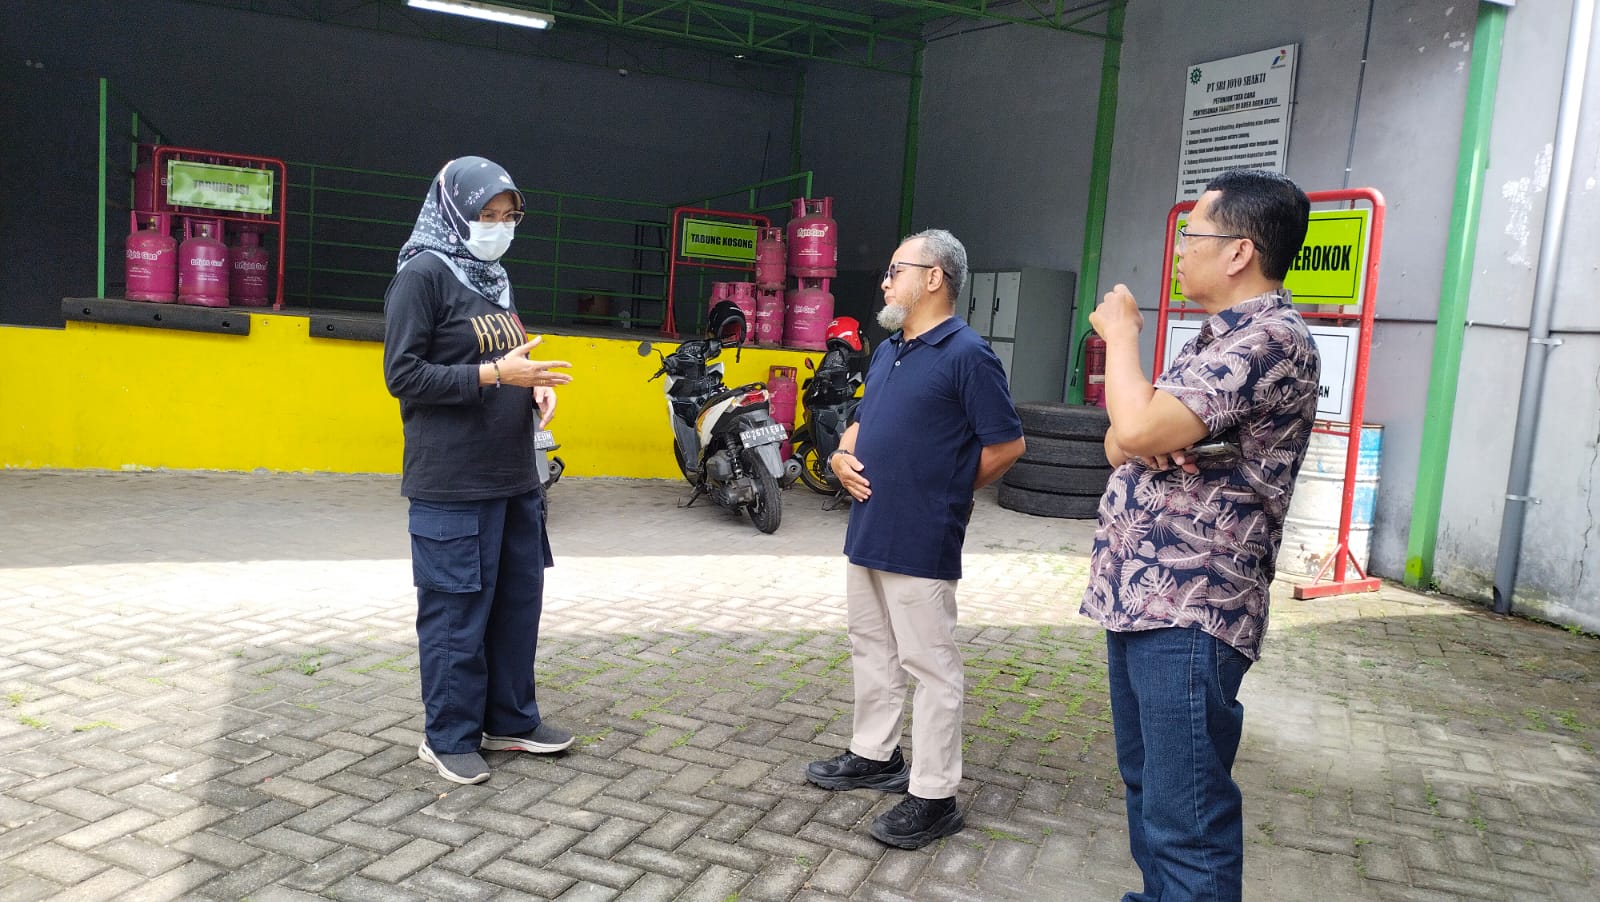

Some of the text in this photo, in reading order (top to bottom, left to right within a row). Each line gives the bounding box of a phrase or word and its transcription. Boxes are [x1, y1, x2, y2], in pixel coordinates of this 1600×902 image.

[1206, 81, 1216, 93] PT
[1216, 80, 1226, 92] SRI
[1243, 72, 1266, 86] SHAKTI
[193, 179, 250, 195] TABUNG ISI
[691, 233, 753, 249] TABUNG KOSONG
[470, 310, 529, 354] KEDI
[1318, 385, 1330, 399] AN
